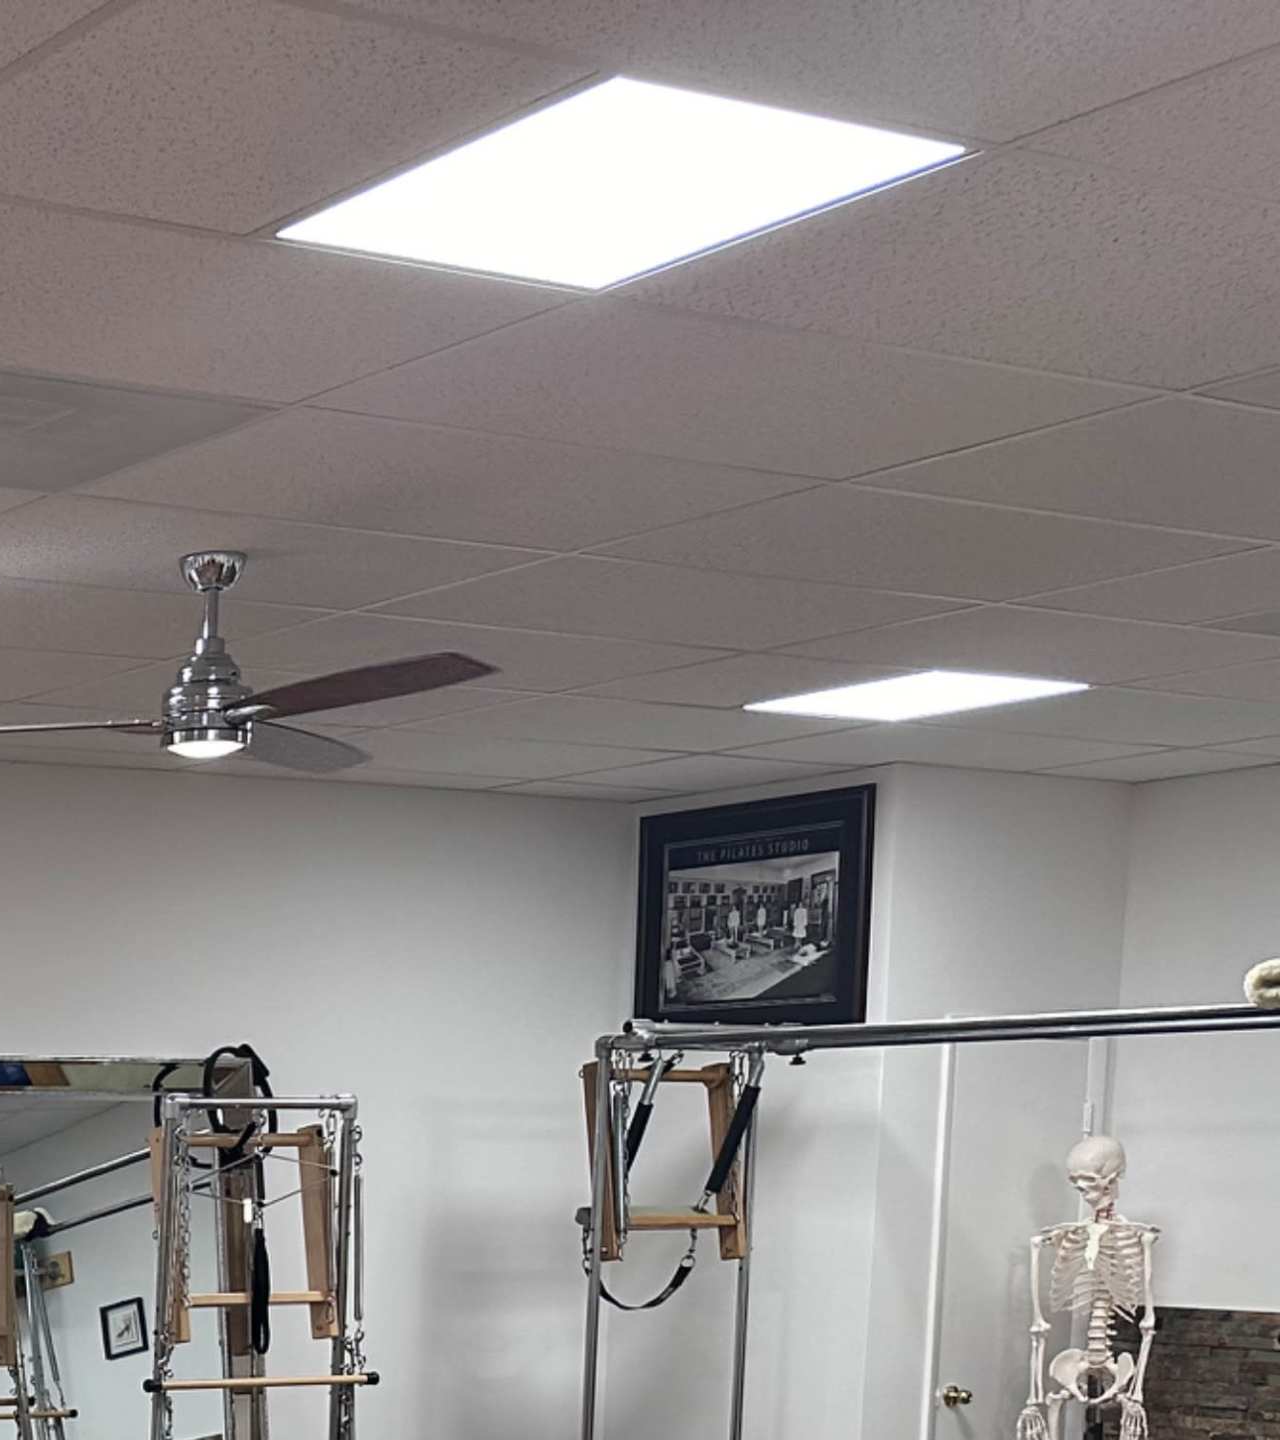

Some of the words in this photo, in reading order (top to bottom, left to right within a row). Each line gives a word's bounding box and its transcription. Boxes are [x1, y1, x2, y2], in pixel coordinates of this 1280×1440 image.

[696, 850, 717, 862] THE
[720, 845, 765, 861] PILATES
[767, 839, 809, 855] STUDIO
